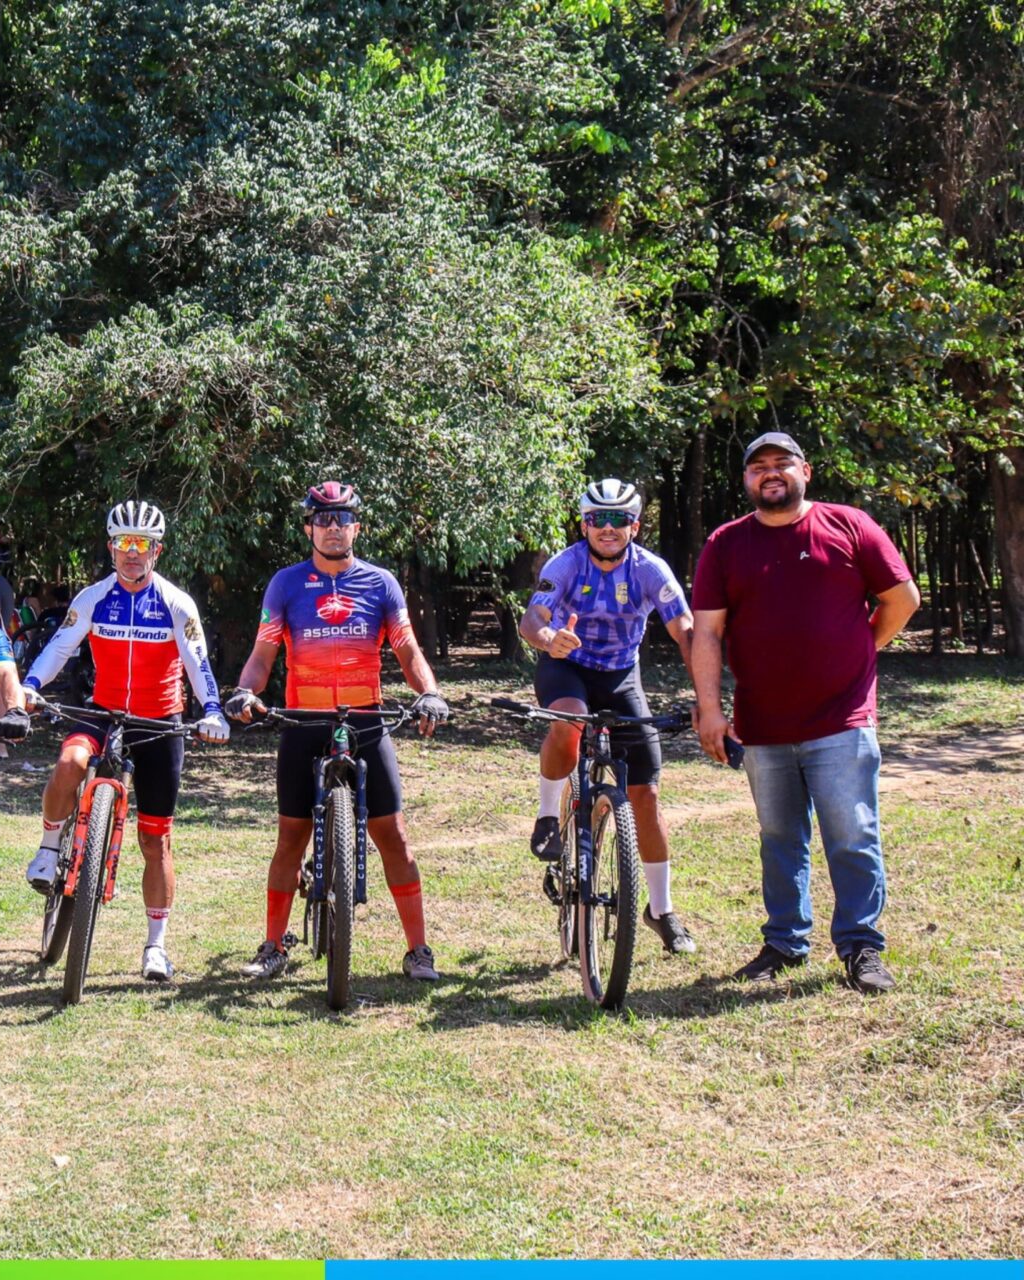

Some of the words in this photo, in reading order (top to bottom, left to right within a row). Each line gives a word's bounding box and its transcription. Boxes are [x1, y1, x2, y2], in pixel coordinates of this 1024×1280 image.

[98, 625, 126, 638] Team
[128, 628, 168, 640] Honda
[206, 672, 219, 698] Team
[315, 818, 325, 879] MANITOU
[357, 819, 367, 880] MANITOU
